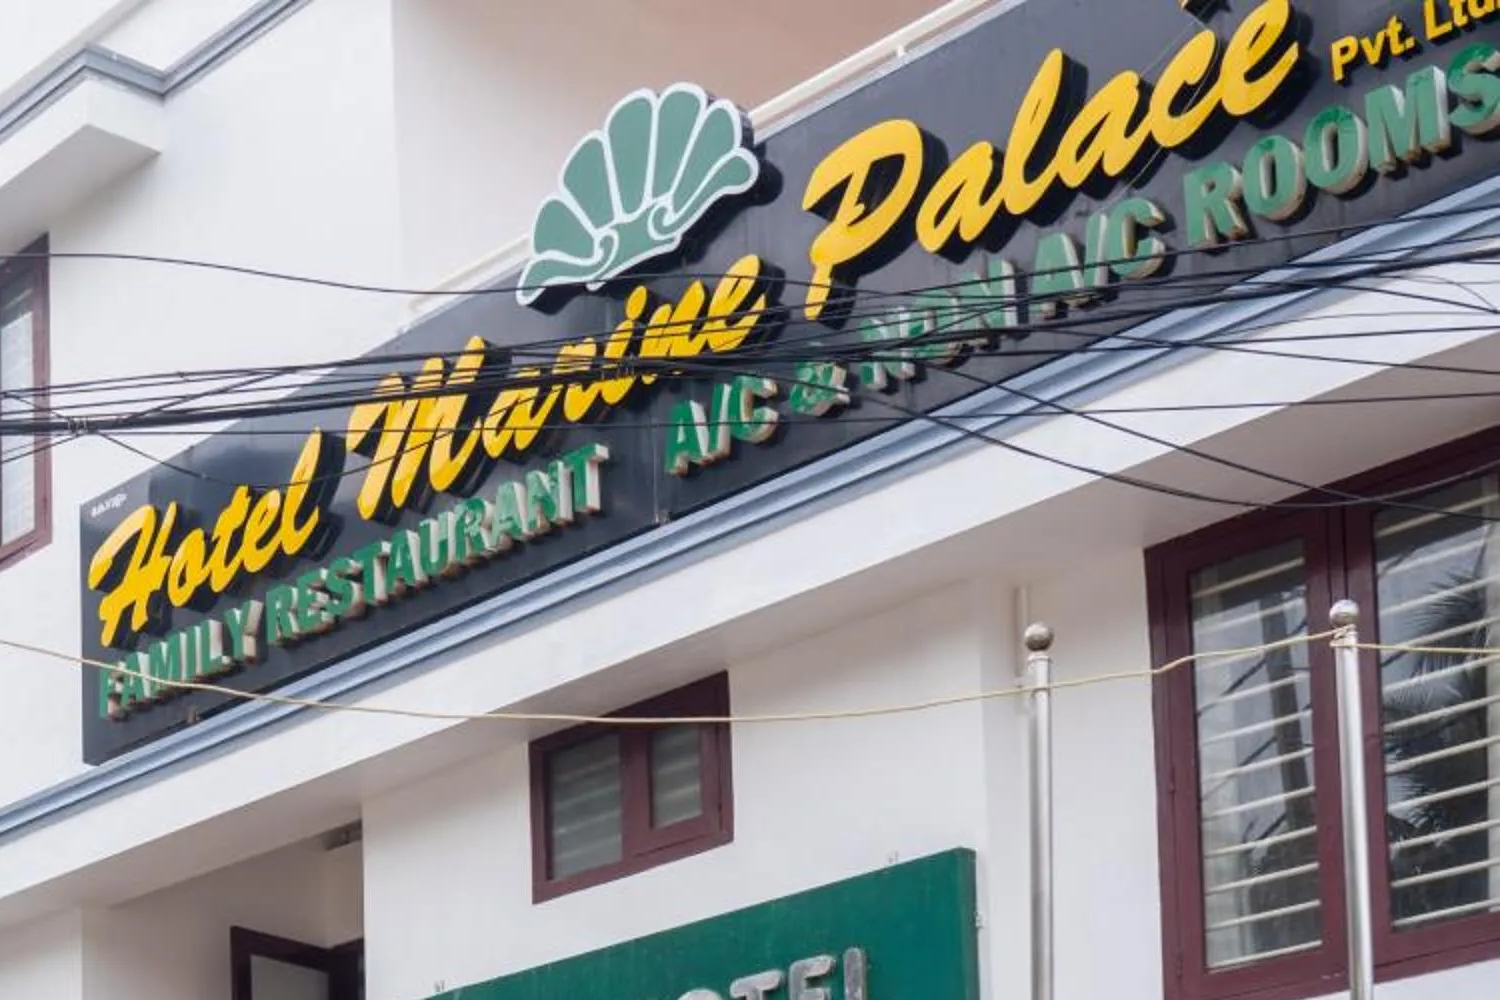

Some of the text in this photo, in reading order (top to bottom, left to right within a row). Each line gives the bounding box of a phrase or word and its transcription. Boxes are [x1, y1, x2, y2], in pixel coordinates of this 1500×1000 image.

[88, 427, 322, 647] Hotel
[346, 254, 766, 520] Marine
[802, 0, 1298, 321] Palace
[1331, 15, 1416, 82] Pvt.
[99, 599, 263, 721] FAMILY
[266, 442, 609, 648] RESTAURANT
[1183, 41, 1500, 247] ROOMS
